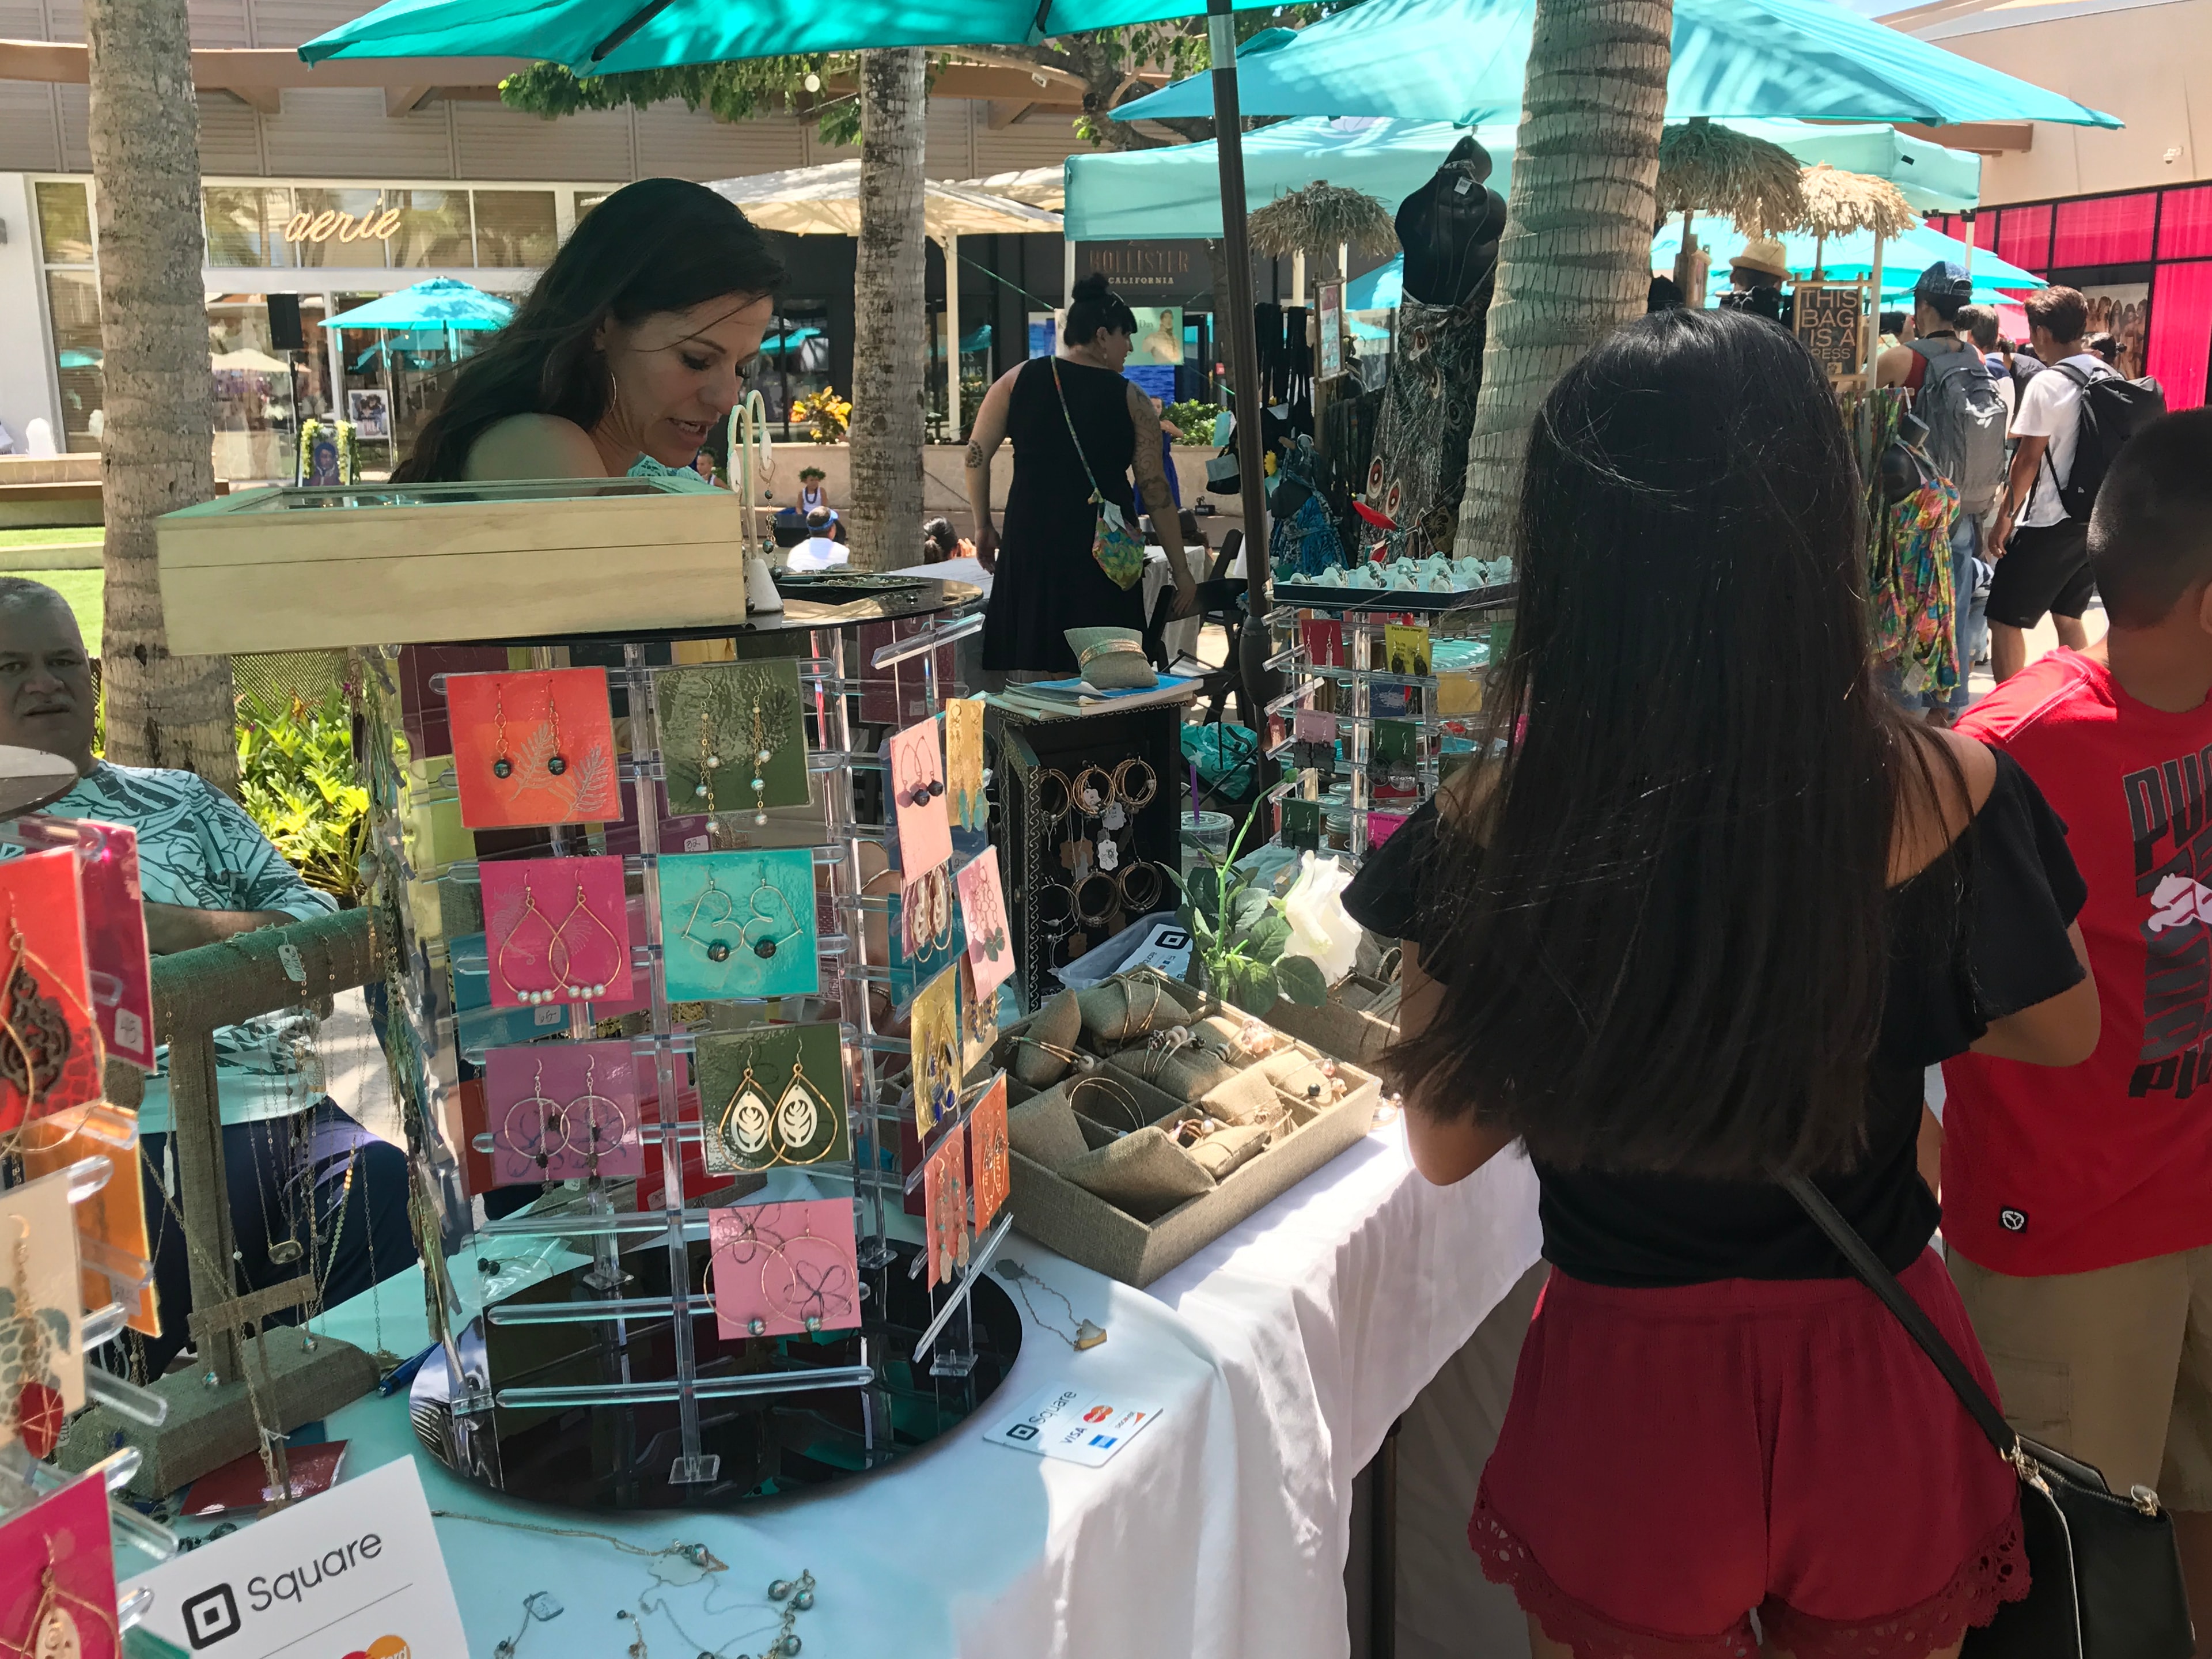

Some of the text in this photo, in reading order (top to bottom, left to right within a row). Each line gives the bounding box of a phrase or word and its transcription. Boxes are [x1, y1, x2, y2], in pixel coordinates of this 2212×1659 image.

[285, 197, 402, 243] aerie
[1090, 250, 1189, 274] HOLLISTER
[1801, 290, 1857, 308] THIS
[1801, 309, 1854, 328] BAG
[1810, 328, 1855, 347] IS A
[961, 366, 983, 378] ANS
[2123, 743, 2212, 877] PU
[1029, 1390, 1077, 1425] Square
[1059, 1426, 1088, 1445] VISA
[247, 1533, 382, 1612] Square
